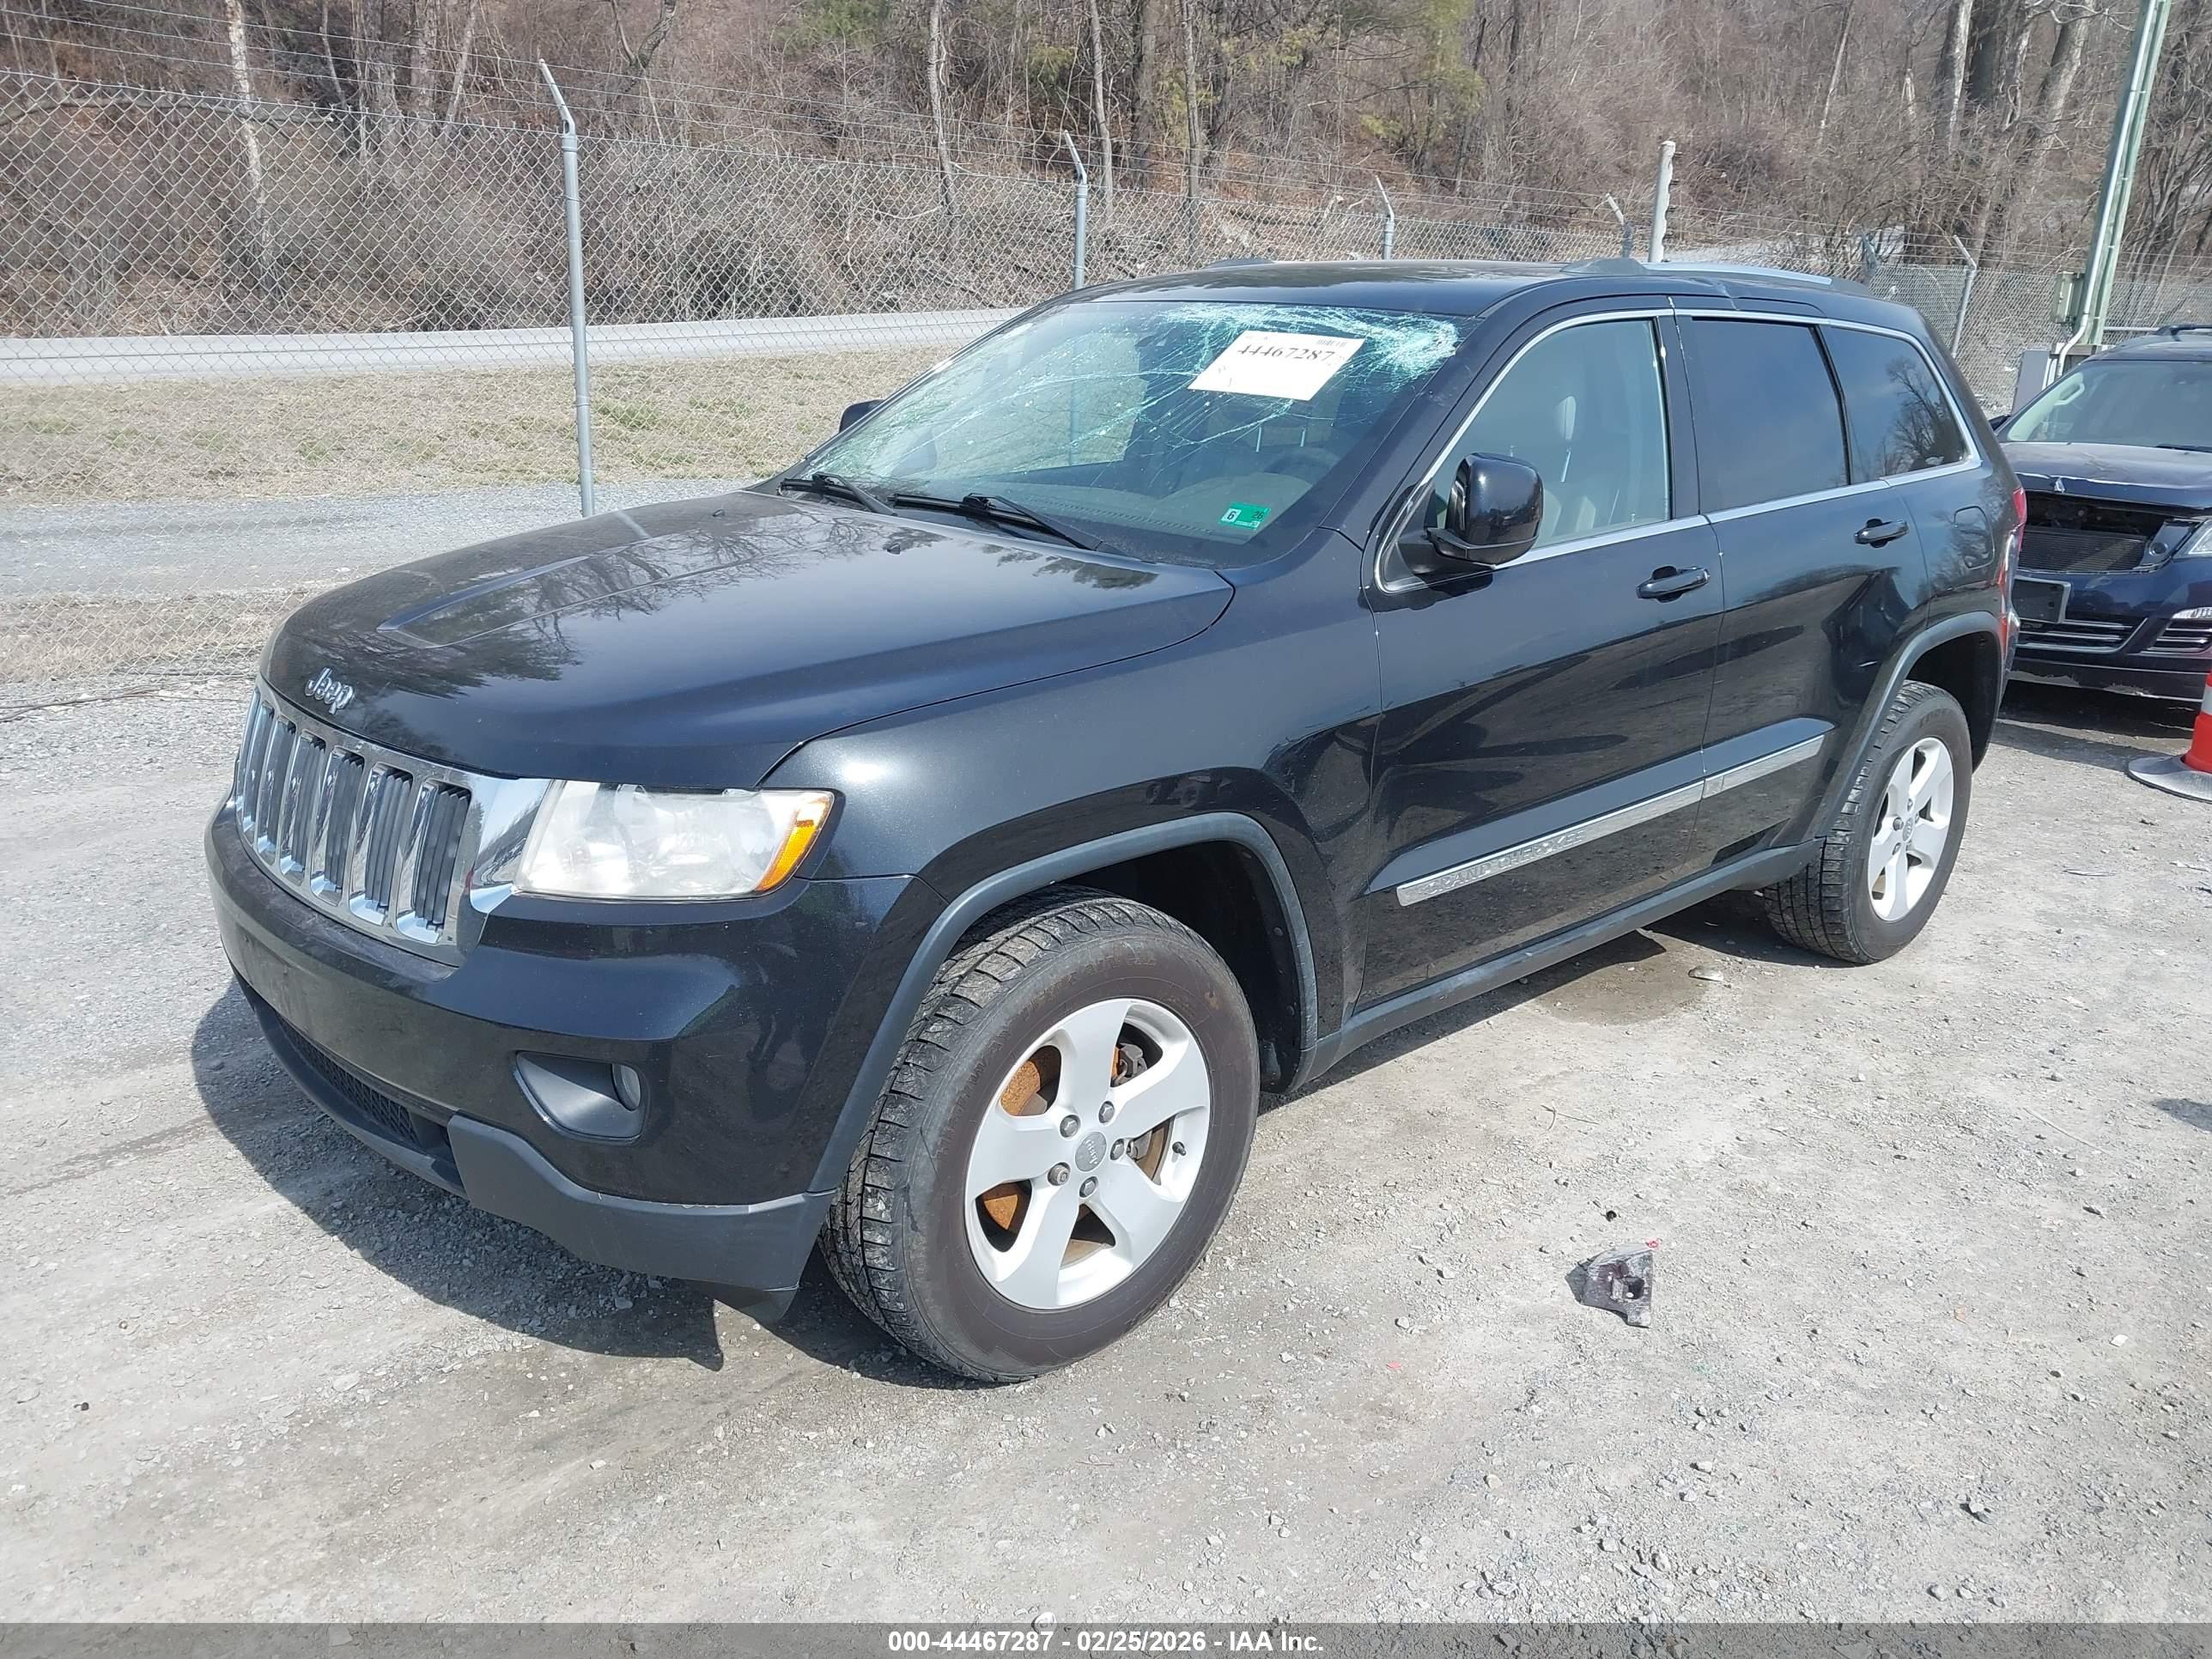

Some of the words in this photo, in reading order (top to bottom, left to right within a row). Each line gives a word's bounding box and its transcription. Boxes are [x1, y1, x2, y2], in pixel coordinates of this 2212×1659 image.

[1237, 343, 1336, 362] 44467287
[1227, 510, 1237, 520] 6
[1252, 510, 1265, 520] 26
[304, 667, 353, 714] Jeep
